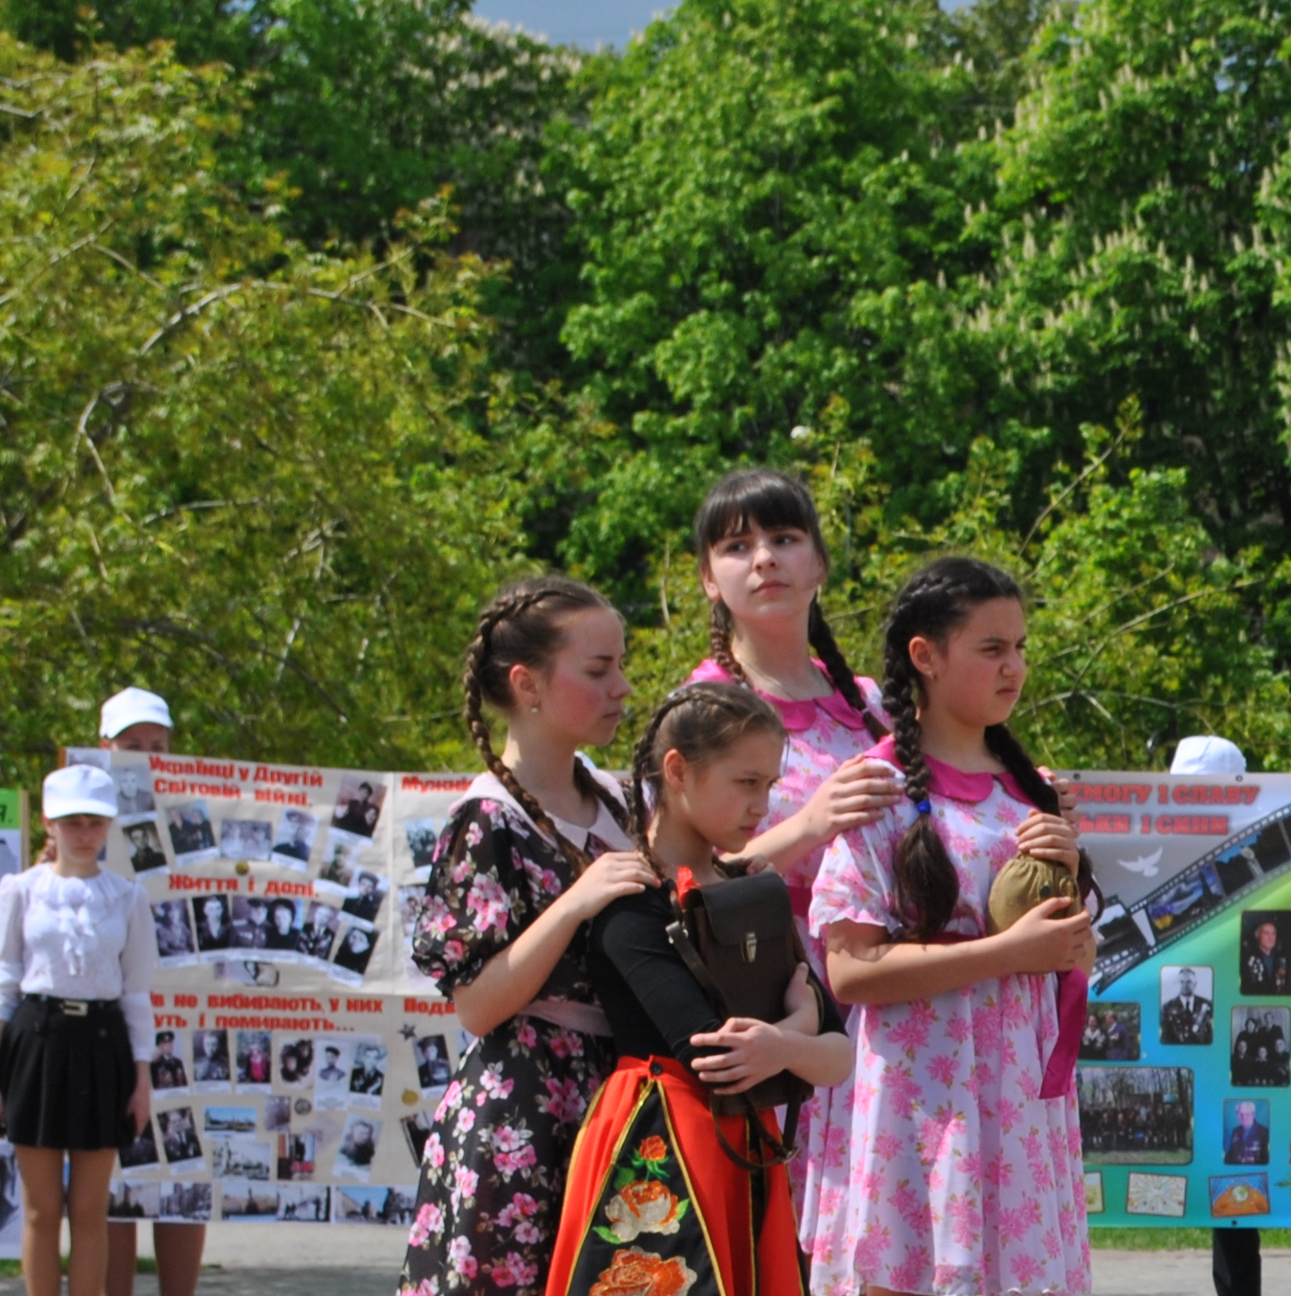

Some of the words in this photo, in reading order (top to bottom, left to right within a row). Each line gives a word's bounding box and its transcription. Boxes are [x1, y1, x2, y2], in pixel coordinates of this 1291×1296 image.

[149, 754, 235, 779] Українці
[239, 766, 249, 782] у
[253, 763, 323, 788] Другій
[154, 778, 242, 801] Світовій
[254, 787, 313, 808] війні.
[1172, 785, 1260, 806] СЛАВУ
[1155, 815, 1229, 836] СИНИ
[168, 874, 239, 892] Життя
[264, 880, 320, 898] долі.
[174, 993, 198, 1008] не
[346, 998, 385, 1014] них
